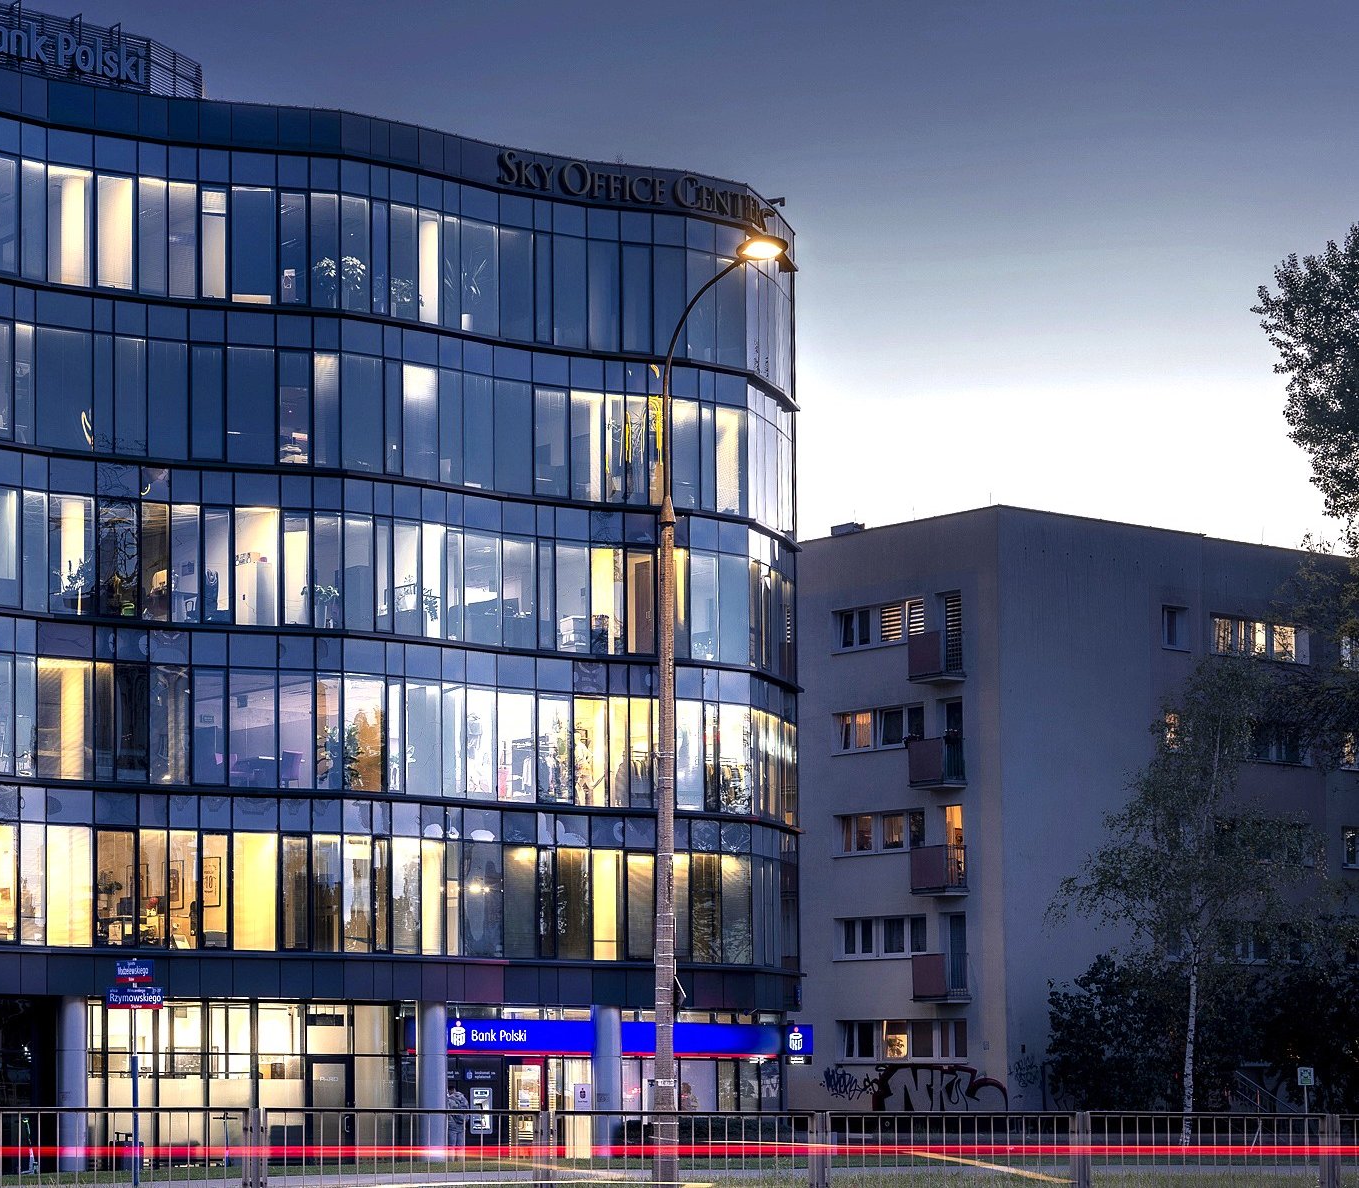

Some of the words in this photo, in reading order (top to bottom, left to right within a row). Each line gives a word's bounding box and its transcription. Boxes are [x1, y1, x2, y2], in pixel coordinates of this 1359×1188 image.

[55, 31, 145, 84] Polski
[499, 150, 554, 192] SKY
[561, 160, 666, 205] OFFICE
[109, 993, 162, 1005] Rzymowskiego
[471, 1028, 497, 1042] Bank
[499, 1028, 527, 1042] Polski
